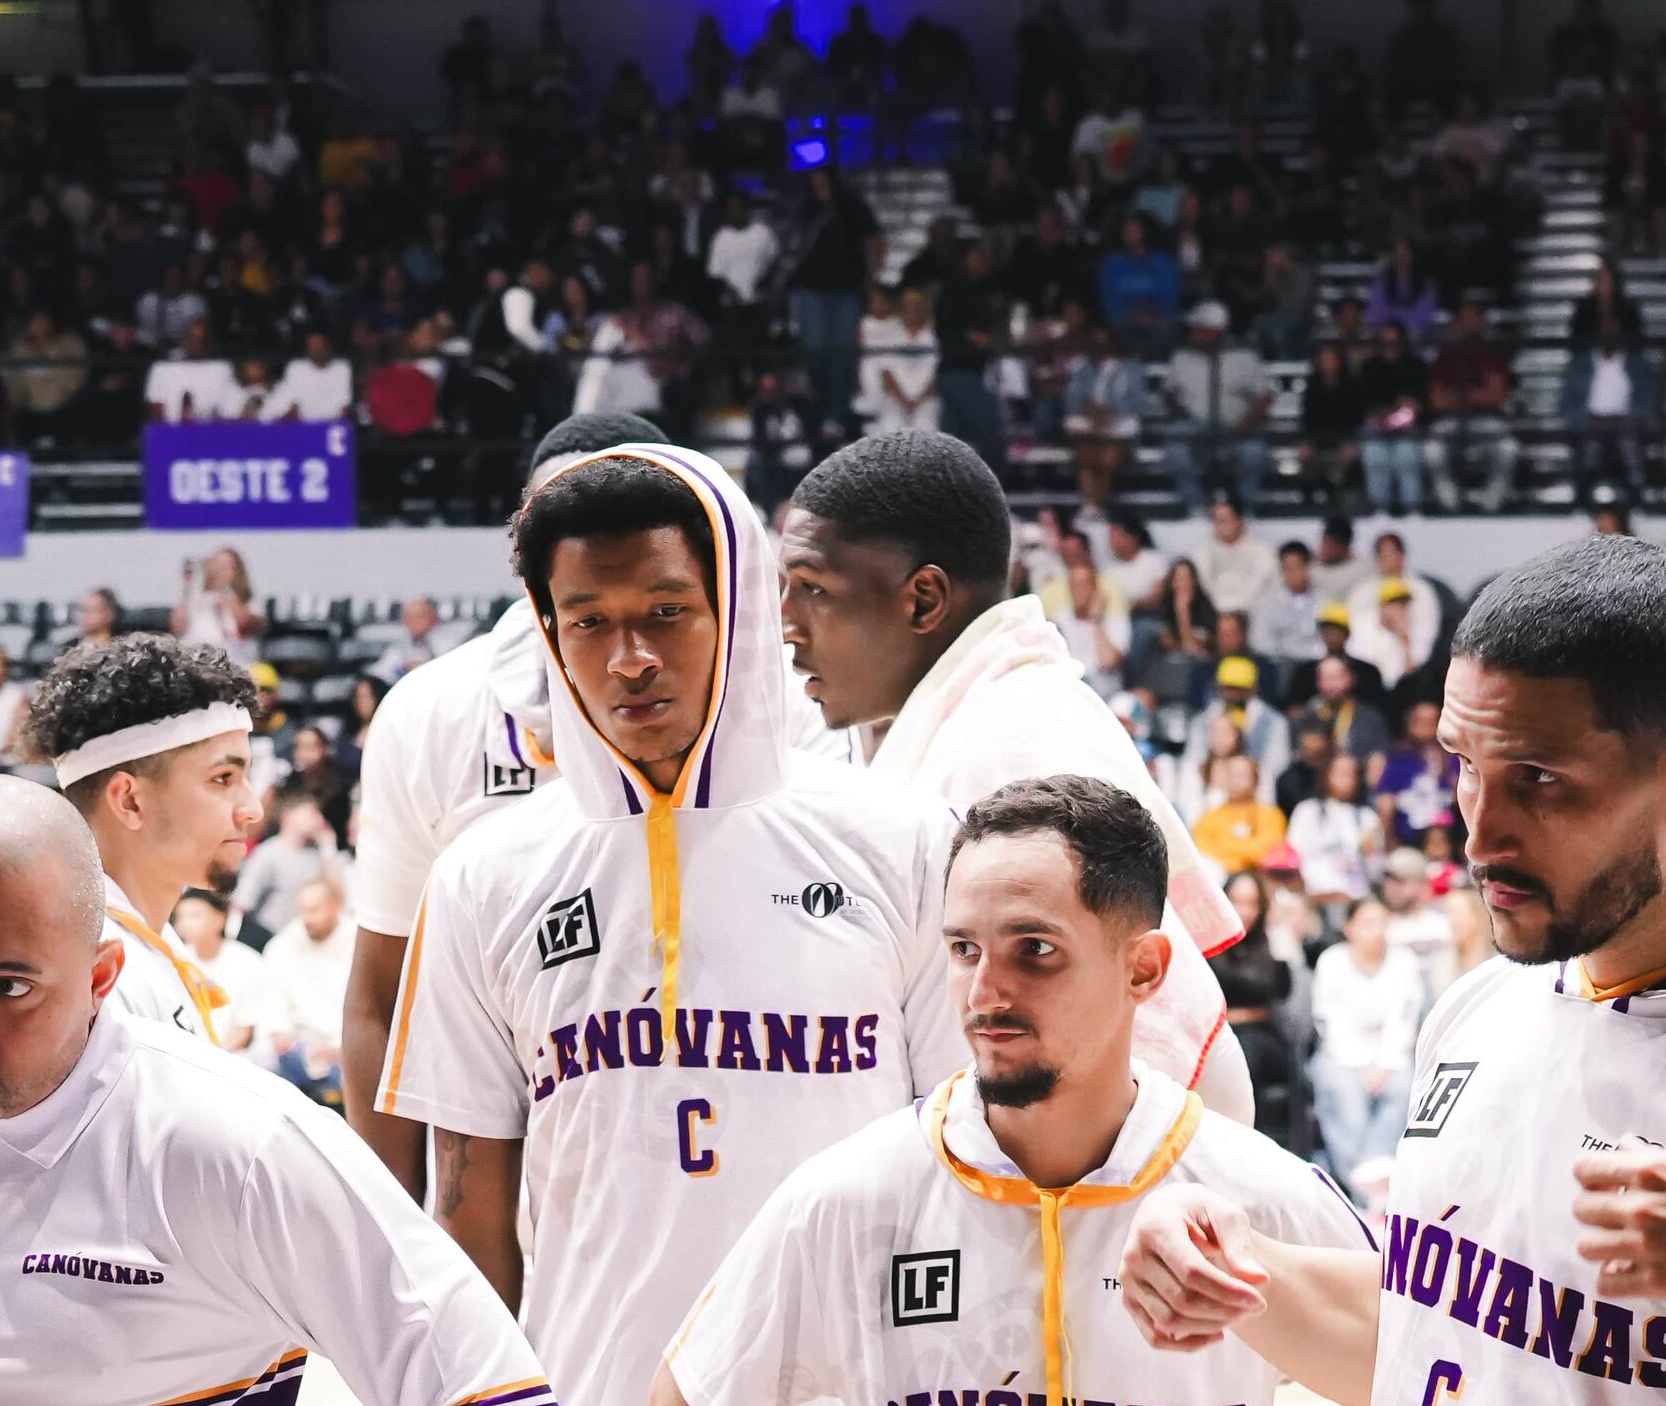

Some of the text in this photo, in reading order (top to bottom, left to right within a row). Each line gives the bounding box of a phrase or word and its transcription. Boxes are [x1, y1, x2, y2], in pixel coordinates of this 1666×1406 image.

[170, 458, 329, 504] OESTE 2
[771, 893, 800, 906] THE
[533, 986, 881, 1103] CANÓVANAS
[677, 1097, 720, 1178] C
[904, 1264, 950, 1313] LF
